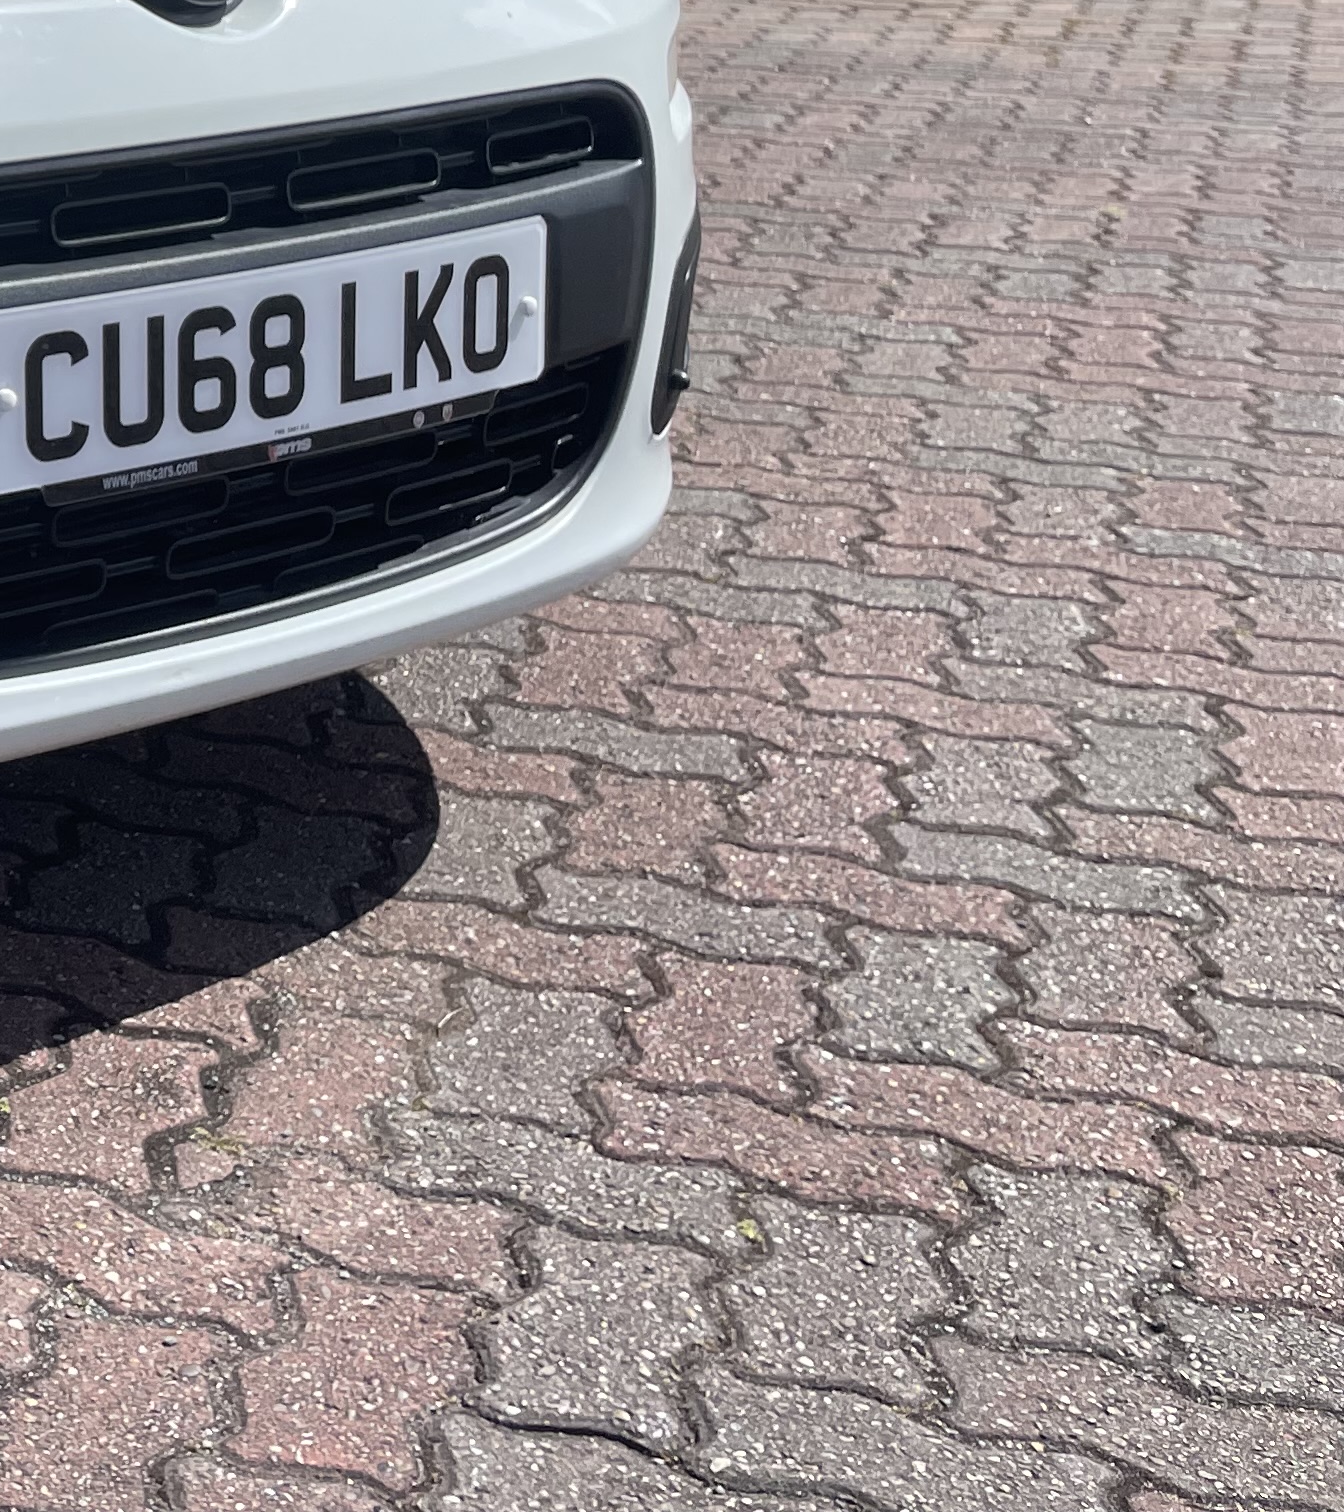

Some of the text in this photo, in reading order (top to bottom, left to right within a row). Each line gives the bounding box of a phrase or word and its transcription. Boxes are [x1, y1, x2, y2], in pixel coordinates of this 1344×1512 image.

[24, 254, 510, 462] CU68 LKO
[102, 459, 199, 490] www.pmscars.com
